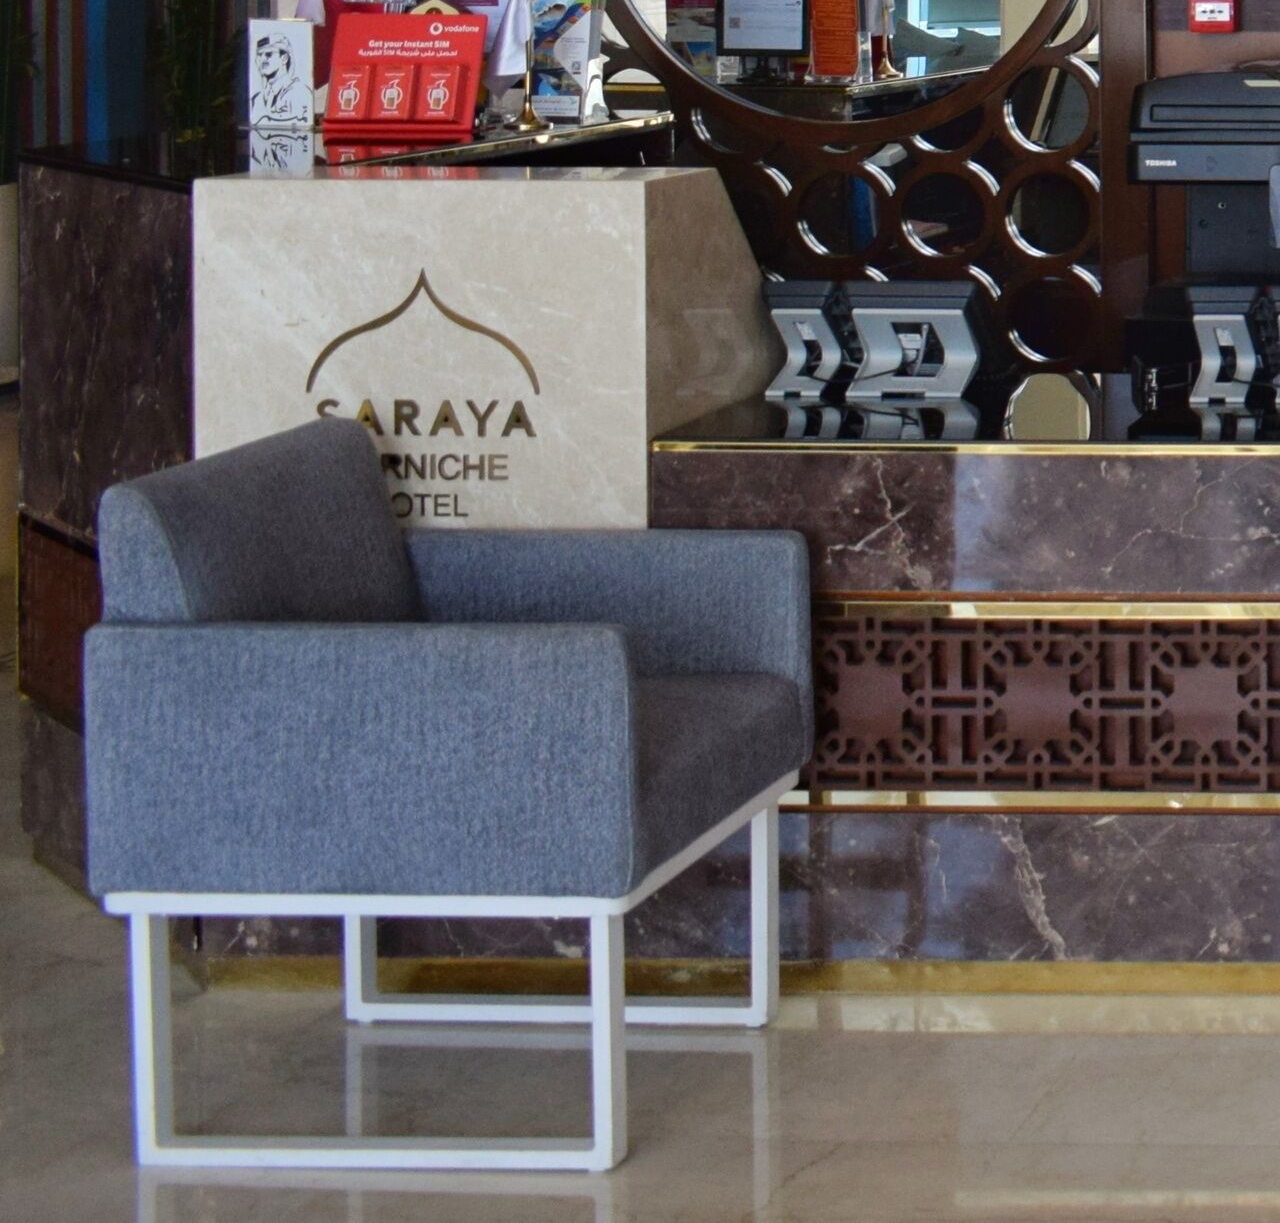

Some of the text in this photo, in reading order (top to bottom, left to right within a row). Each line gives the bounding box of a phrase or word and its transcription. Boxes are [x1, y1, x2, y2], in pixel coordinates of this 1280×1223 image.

[444, 23, 480, 33] vodafone
[368, 40, 449, 49] Get your Instant SIM
[382, 453, 509, 481] RNICHE
[392, 493, 468, 519] OTEL
